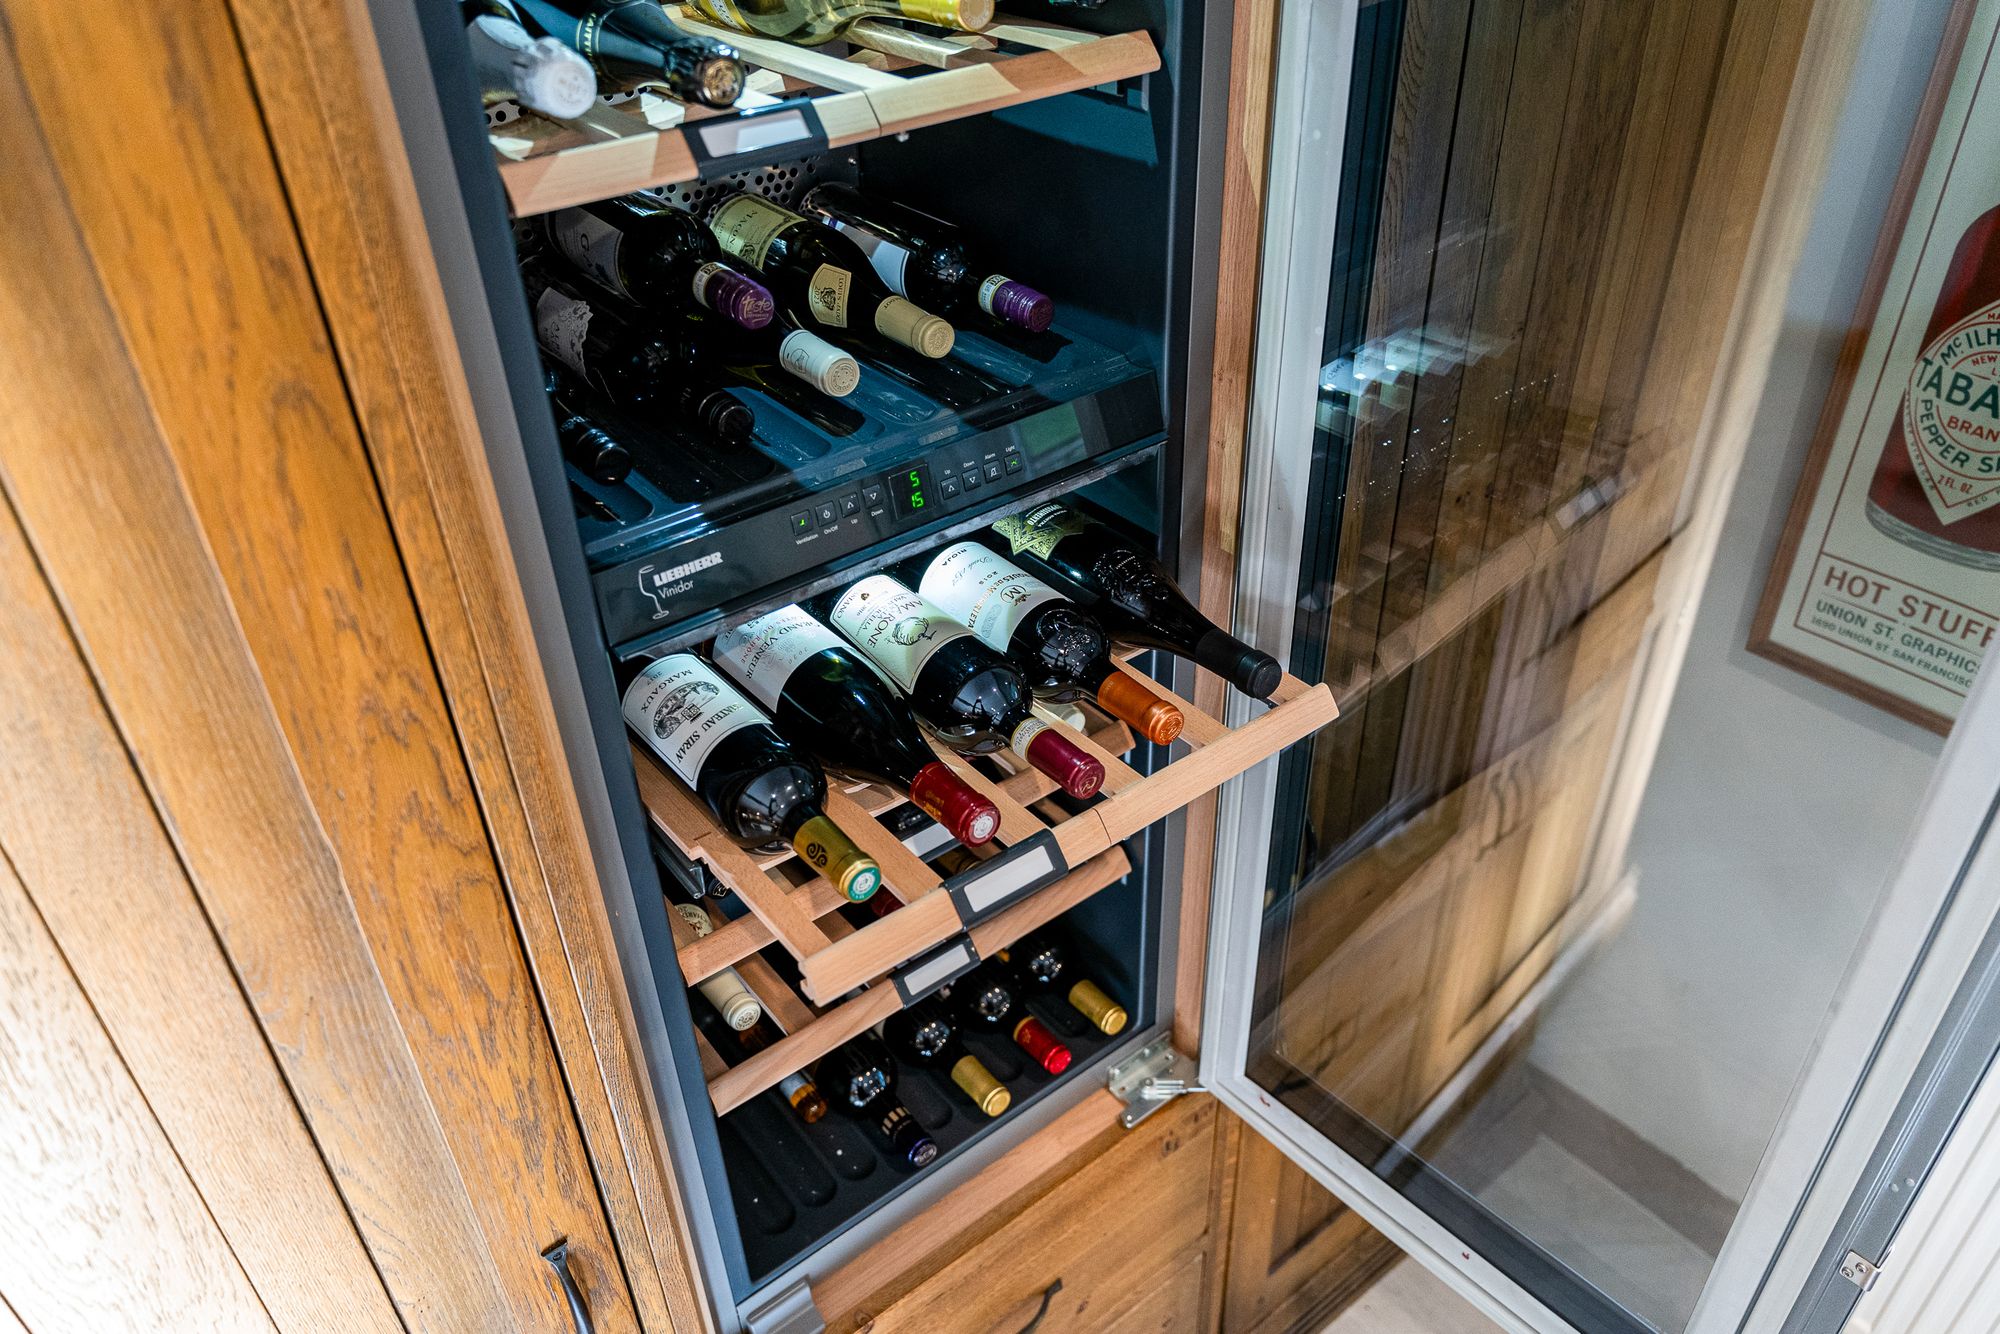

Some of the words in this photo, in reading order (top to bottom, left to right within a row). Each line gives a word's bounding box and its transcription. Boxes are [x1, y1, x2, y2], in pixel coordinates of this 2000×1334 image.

[1919, 398, 1971, 469] PEPPER
[909, 470, 920, 488] 5
[870, 507, 884, 518] Down
[910, 490, 925, 509] 15
[652, 551, 724, 588] LIEBHERR
[942, 548, 968, 567] RIOJA
[657, 580, 695, 600] Vinidor
[1823, 565, 1892, 605] HOT
[1898, 594, 1996, 648] STUFF
[1815, 599, 1868, 629] UNION
[745, 636, 779, 679] VENEUR
[1837, 626, 1873, 647] UNION
[1891, 648, 1916, 665] SAN
[640, 668, 693, 714] MARGAUX
[675, 730, 701, 764] SIRAN
